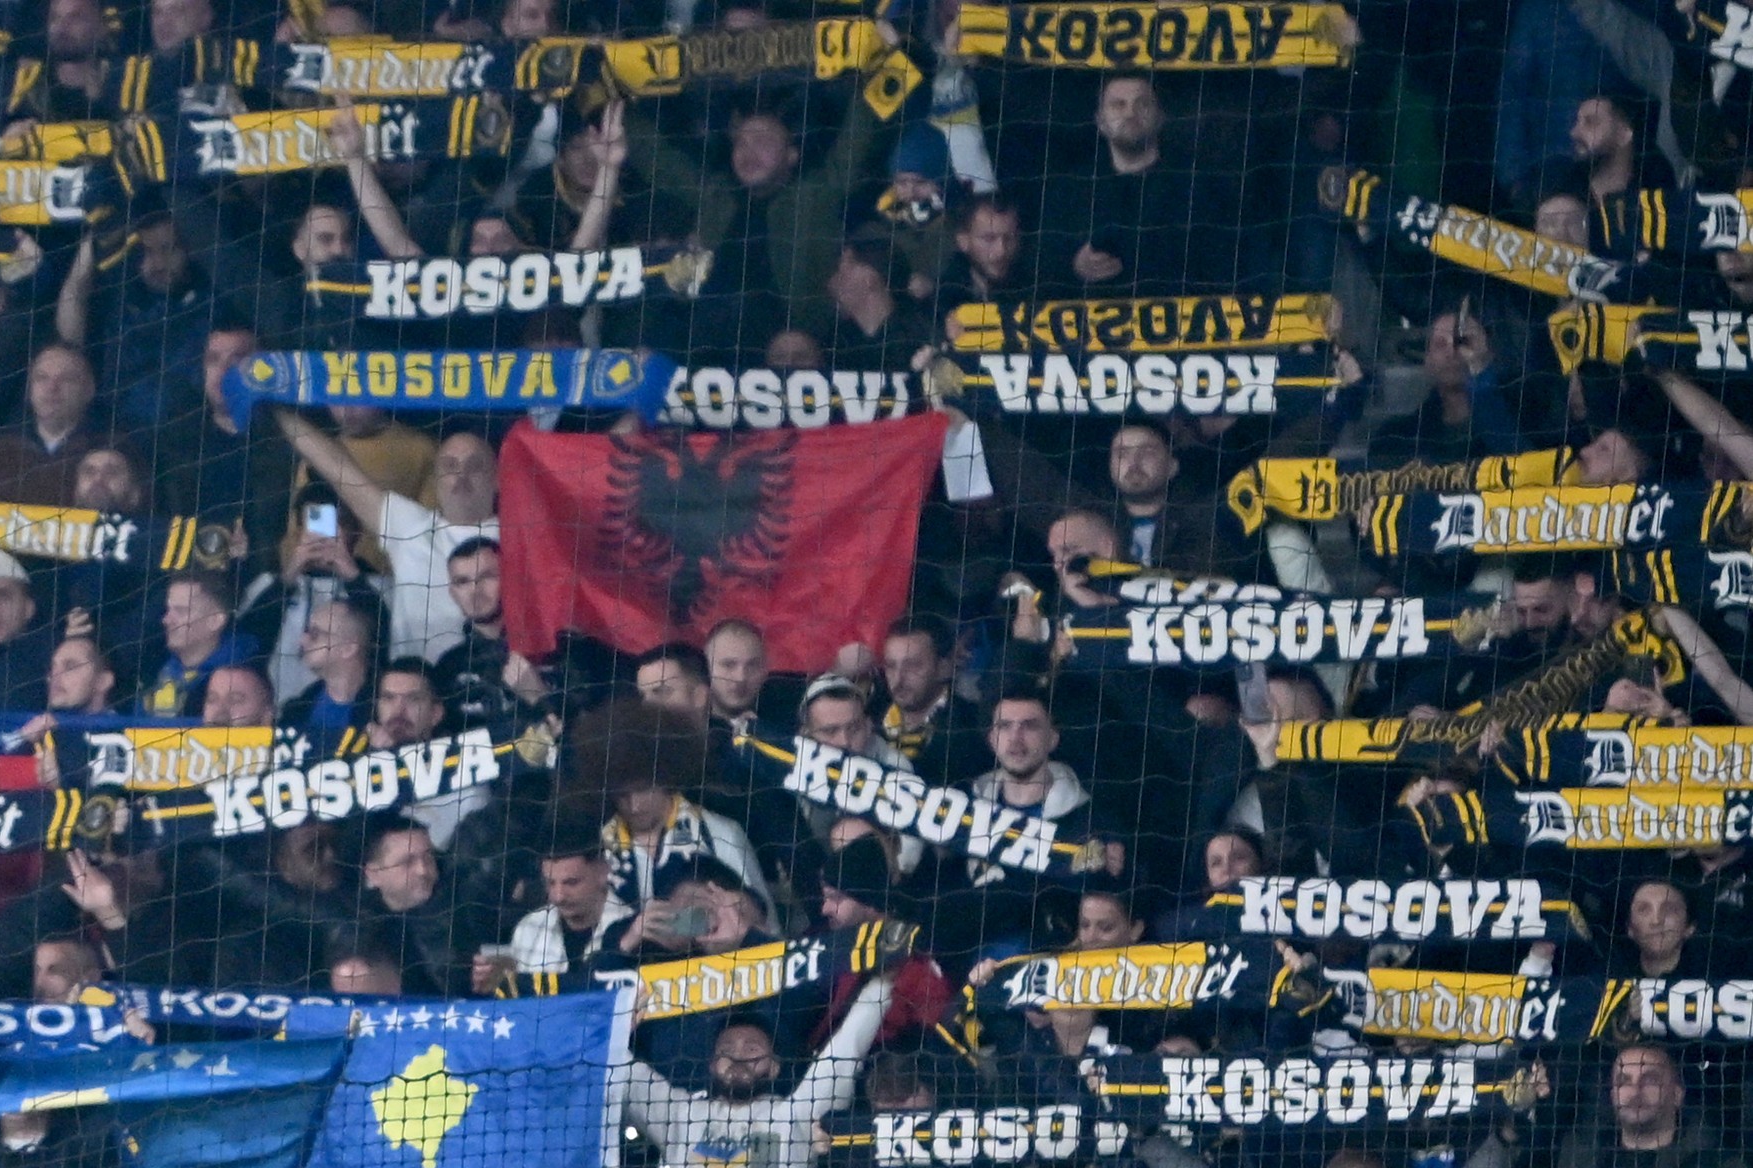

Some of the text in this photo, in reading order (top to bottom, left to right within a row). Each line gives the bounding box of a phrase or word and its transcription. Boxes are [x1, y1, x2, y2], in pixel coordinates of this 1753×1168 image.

[189, 104, 420, 172] Dardnët
[366, 247, 644, 318] KOSOVA
[326, 351, 557, 397] KOSOVA
[981, 354, 1278, 414] KOSOVA
[1431, 485, 1676, 553] Dardanët
[1126, 597, 1430, 663] KOSOVA
[206, 728, 499, 837] KOSOVA
[783, 735, 1058, 872] KOSOVA
[1514, 787, 1753, 845] Dardanë
[1238, 876, 1546, 938] KOSOVA
[1003, 943, 1249, 1010] Dardanët
[1326, 965, 1566, 1042] Dardanët
[1162, 1056, 1478, 1125] KOSOVA
